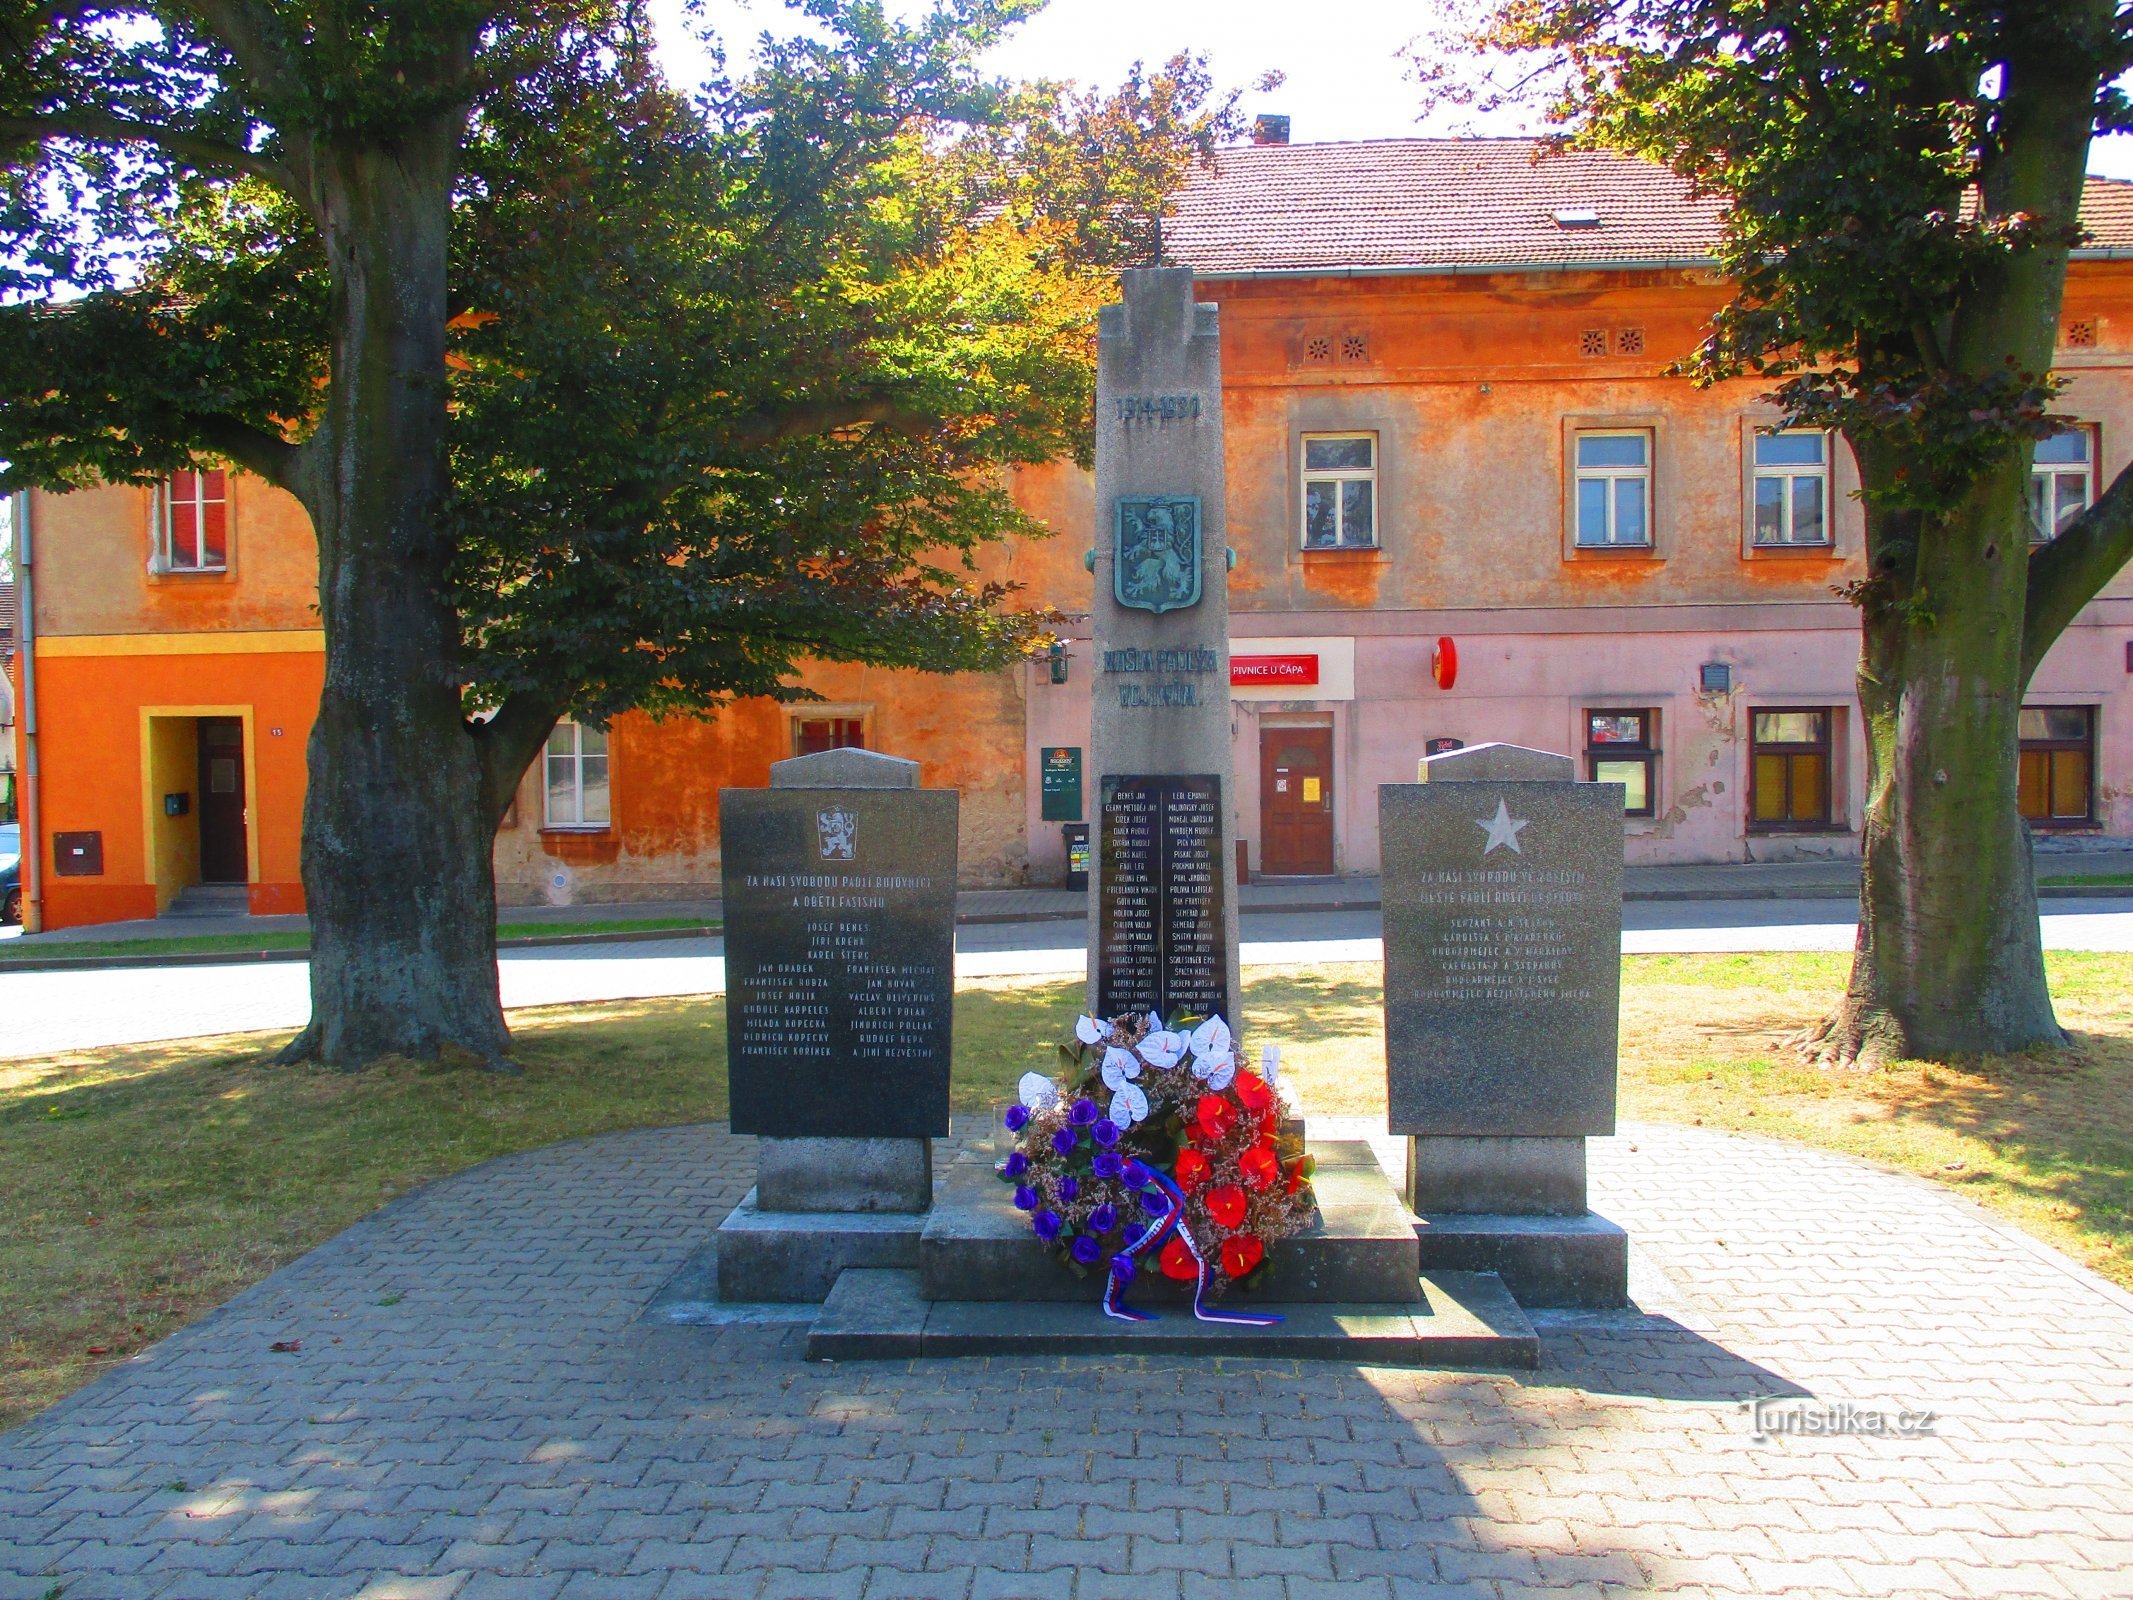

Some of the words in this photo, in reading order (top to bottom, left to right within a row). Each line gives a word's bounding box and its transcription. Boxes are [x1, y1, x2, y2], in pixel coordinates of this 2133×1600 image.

[1233, 665, 1268, 675] PIVNICE
[1270, 665, 1277, 674] U
[1279, 664, 1304, 675] ČÁPA
[747, 875, 758, 887] ZA
[791, 875, 838, 888] SVOBODU
[793, 896, 799, 907] A
[808, 923, 833, 933] JOSEF
[808, 950, 834, 960] KAREL
[758, 964, 773, 974] JAN
[756, 991, 783, 1000] JOSEF
[743, 1005, 779, 1014] RUDOLF
[858, 1006, 891, 1016] ALBERT
[747, 1019, 780, 1028] MILADA
[860, 1034, 895, 1043] RUDOLF
